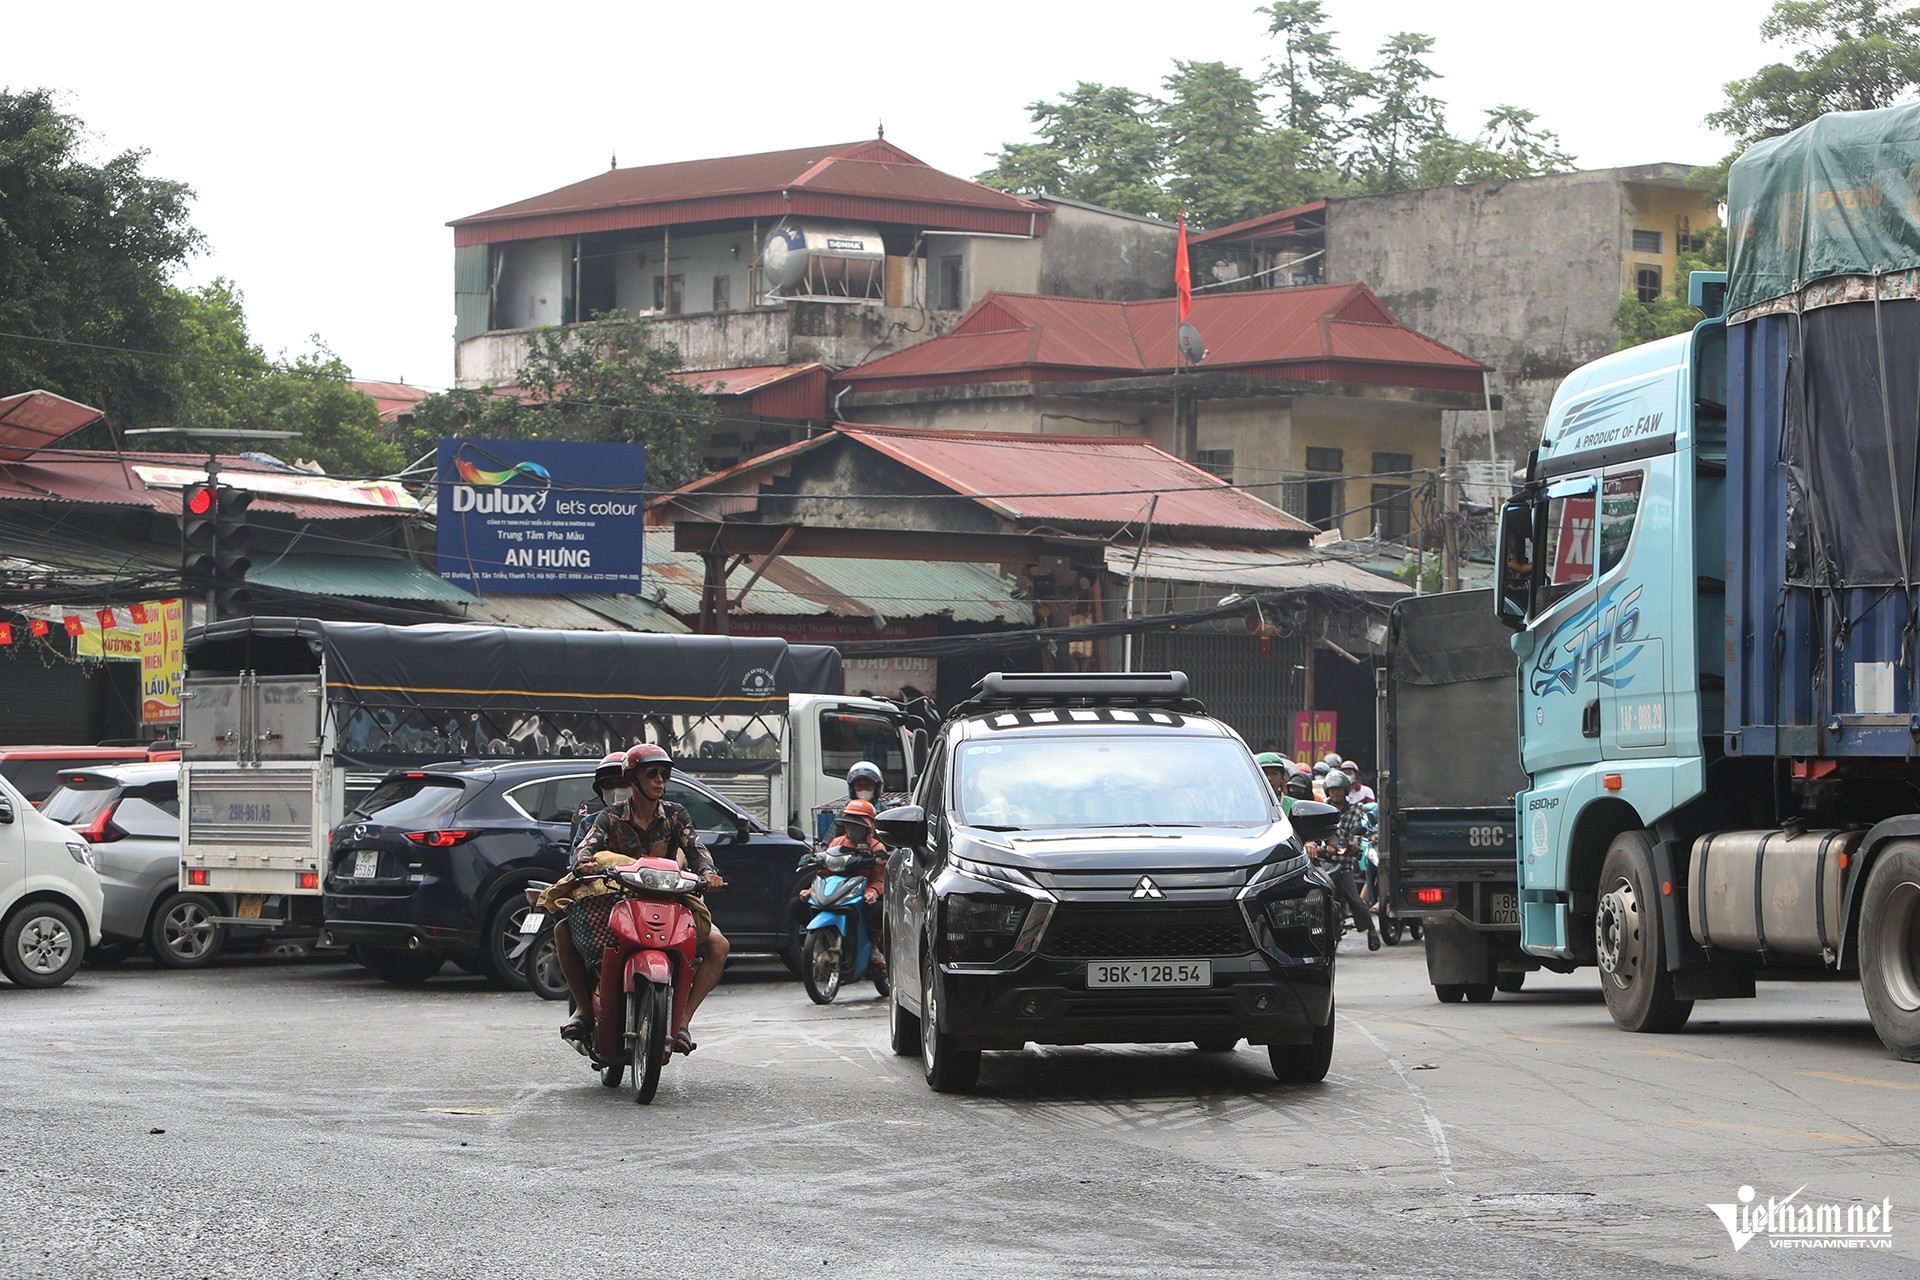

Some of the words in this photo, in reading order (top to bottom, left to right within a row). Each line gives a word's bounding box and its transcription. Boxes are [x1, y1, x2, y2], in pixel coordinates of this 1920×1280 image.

[1575, 437, 1580, 450] A
[1583, 428, 1621, 447] PRODUCT
[1622, 425, 1634, 439] OF
[1635, 412, 1663, 436] FAW
[452, 486, 536, 514] Dulux
[556, 500, 586, 515] let's
[589, 500, 637, 516] colour
[497, 530, 523, 542] Trung
[526, 530, 544, 540] Tâm
[547, 531, 563, 540] Pha
[566, 530, 585, 540] Màu
[504, 548, 533, 567] AN
[537, 546, 591, 568] HƯNG
[729, 621, 750, 631] ÔNG
[1557, 584, 1644, 694] JH6
[145, 674, 165, 696] LẨU
[1300, 713, 1332, 742] TẨM
[229, 803, 271, 821] 29H-961.45
[1529, 797, 1559, 811] 680HP
[1097, 965, 1201, 983] 36K-128.54
